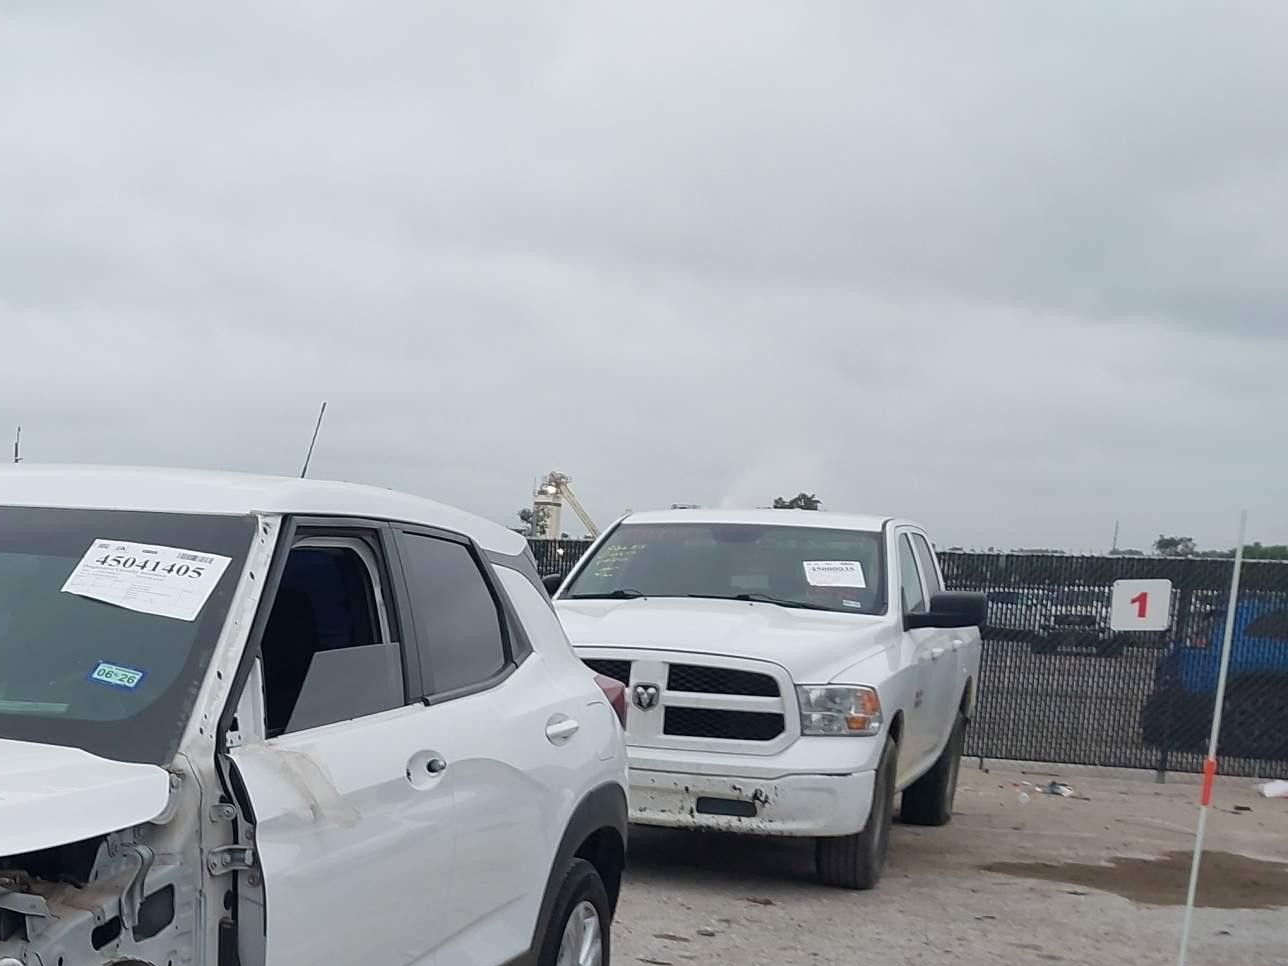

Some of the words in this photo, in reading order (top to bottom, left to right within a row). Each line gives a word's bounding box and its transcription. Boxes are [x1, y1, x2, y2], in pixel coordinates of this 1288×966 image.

[96, 554, 205, 579] 45041405
[1130, 592, 1148, 618] 1
[97, 668, 114, 679] 06
[118, 673, 137, 685] 26
